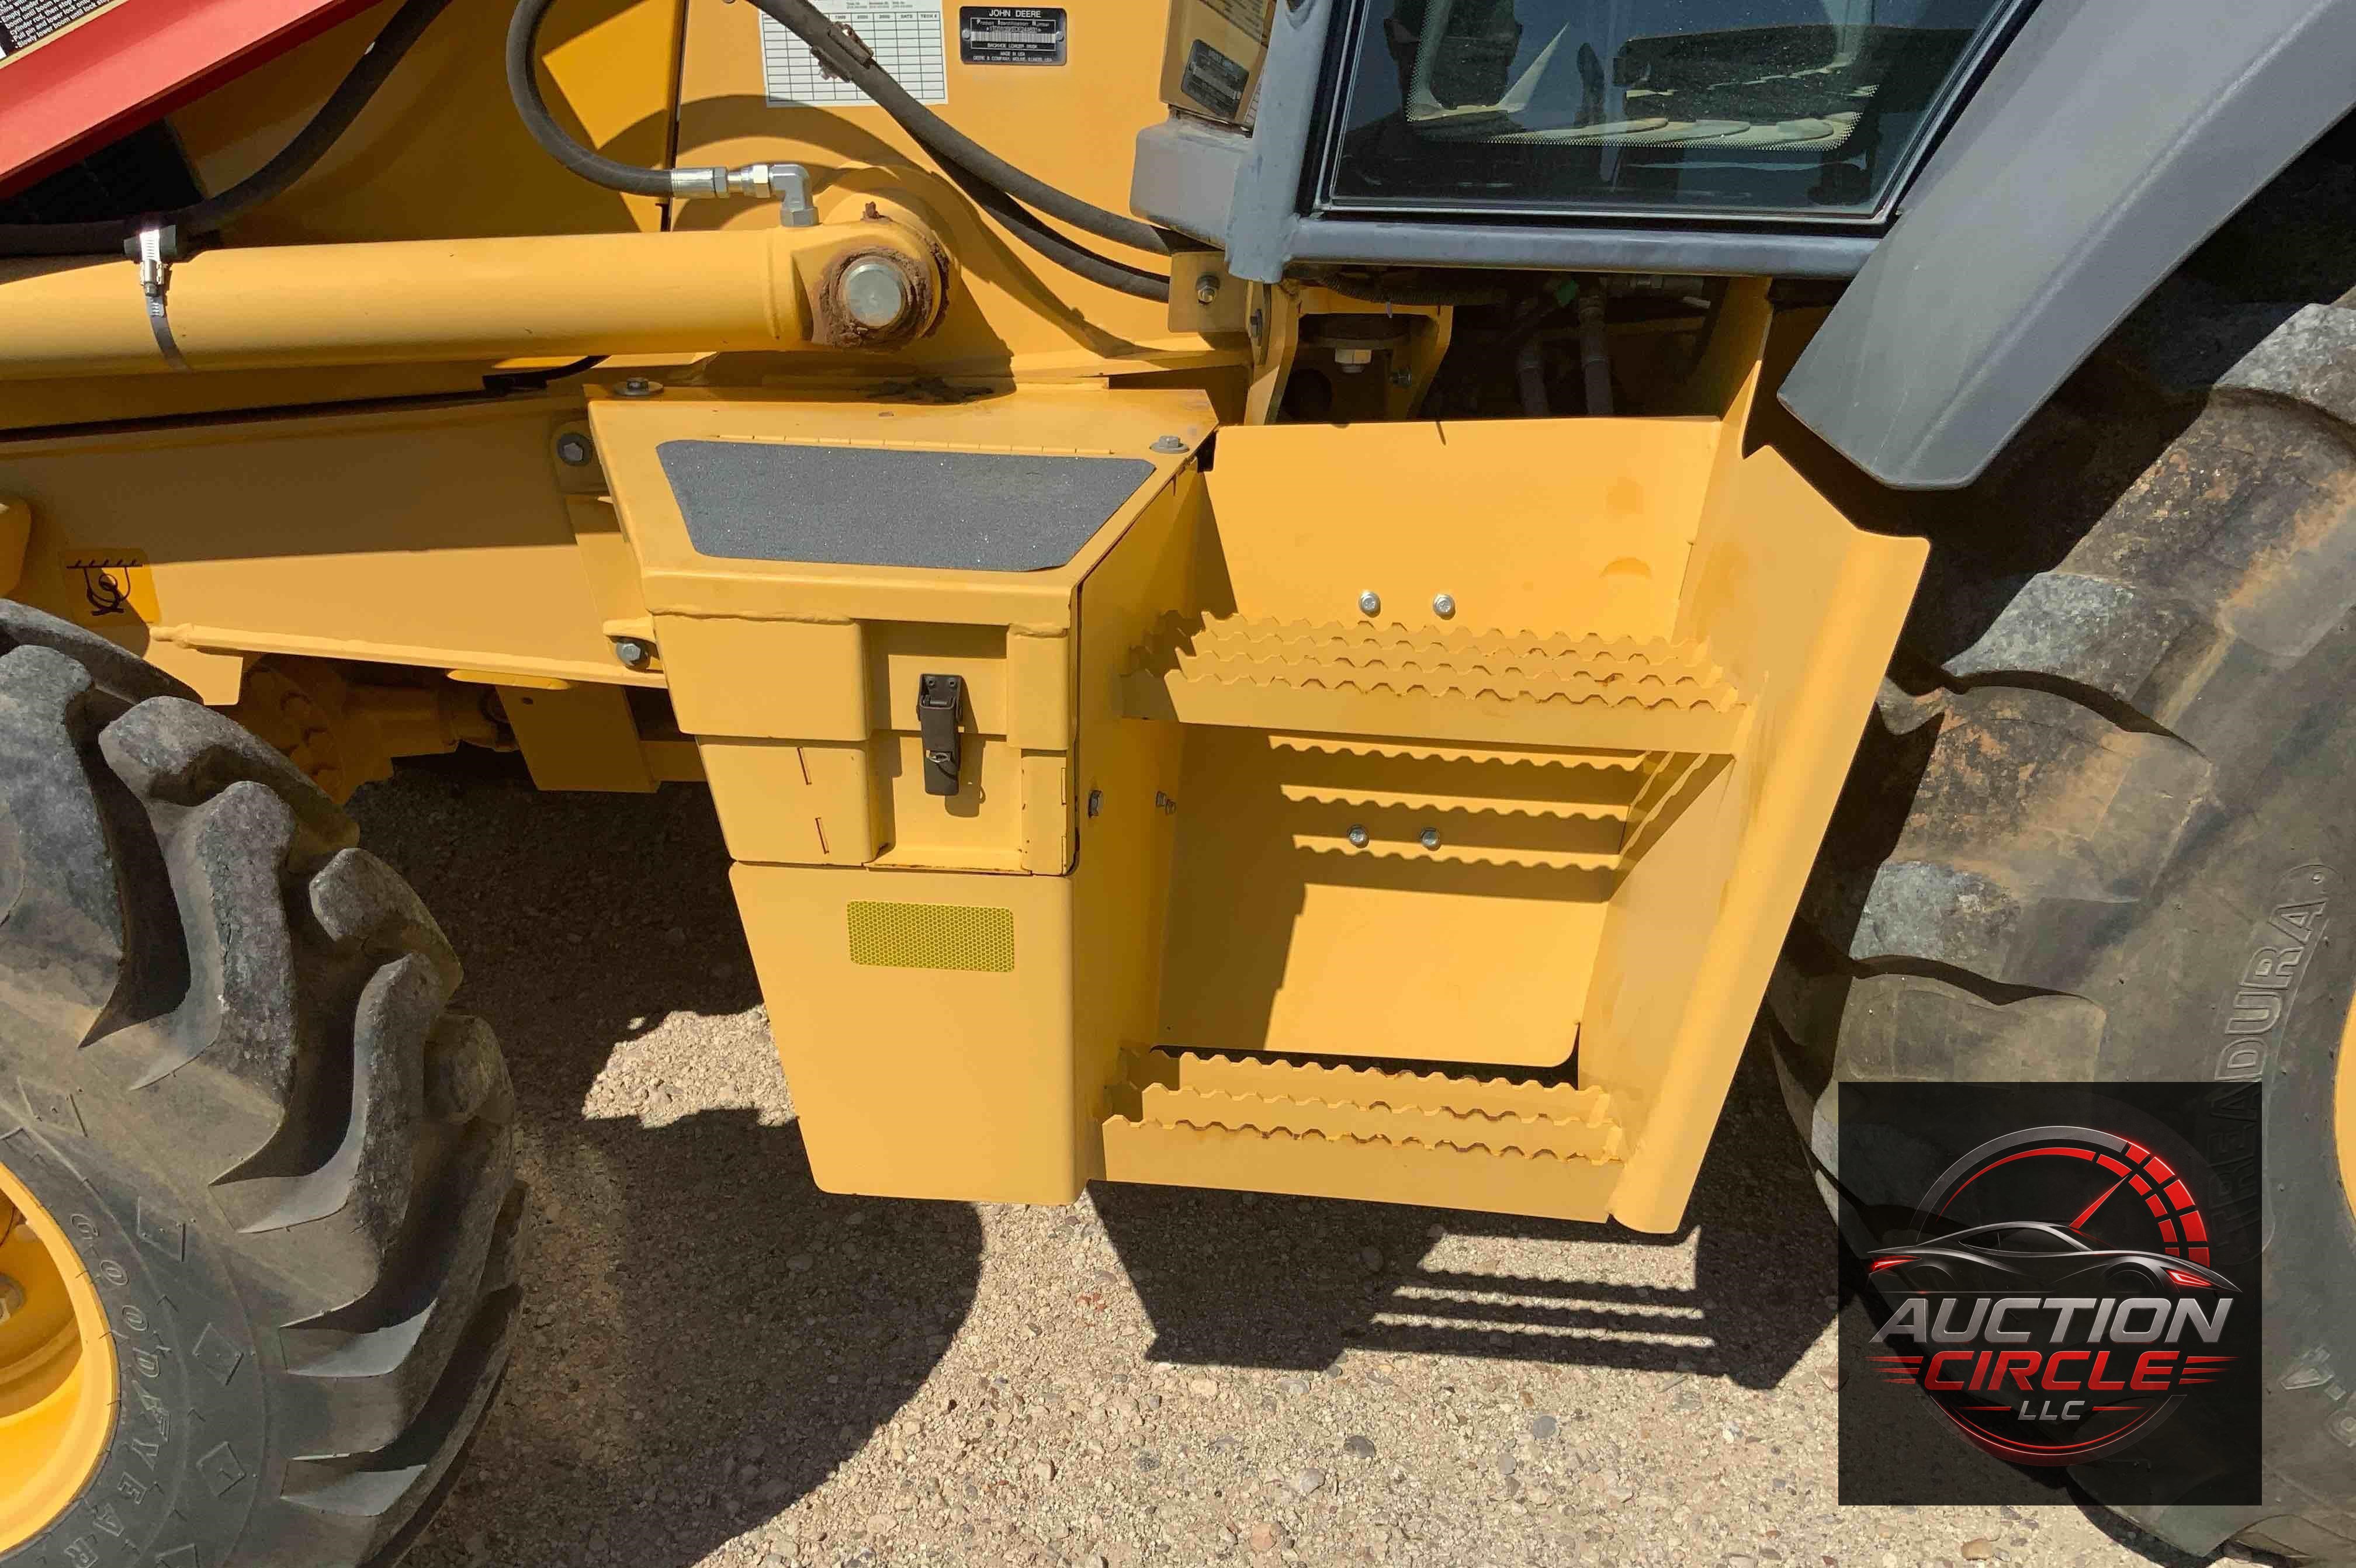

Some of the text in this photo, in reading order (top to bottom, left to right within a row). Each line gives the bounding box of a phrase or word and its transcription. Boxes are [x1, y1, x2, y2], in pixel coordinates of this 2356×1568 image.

[1, 9, 20, 23] Empty
[19, 0, 39, 12] loader
[5, 1, 53, 29] boom until boom
[10, 20, 33, 35] cylinder
[44, 6, 59, 16] then
[58, 0, 72, 10] stop
[13, 32, 26, 41] Pull
[25, 27, 36, 36] pin
[36, 19, 47, 30] and
[46, 12, 63, 23] lower
[63, 5, 77, 15] lock
[17, 34, 37, 48] Slowly
[36, 26, 53, 38] lower
[52, 17, 71, 29] boom
[70, 8, 84, 19] until
[82, 2, 98, 12] lock
[989, 9, 1041, 18] JOHN DEERE
